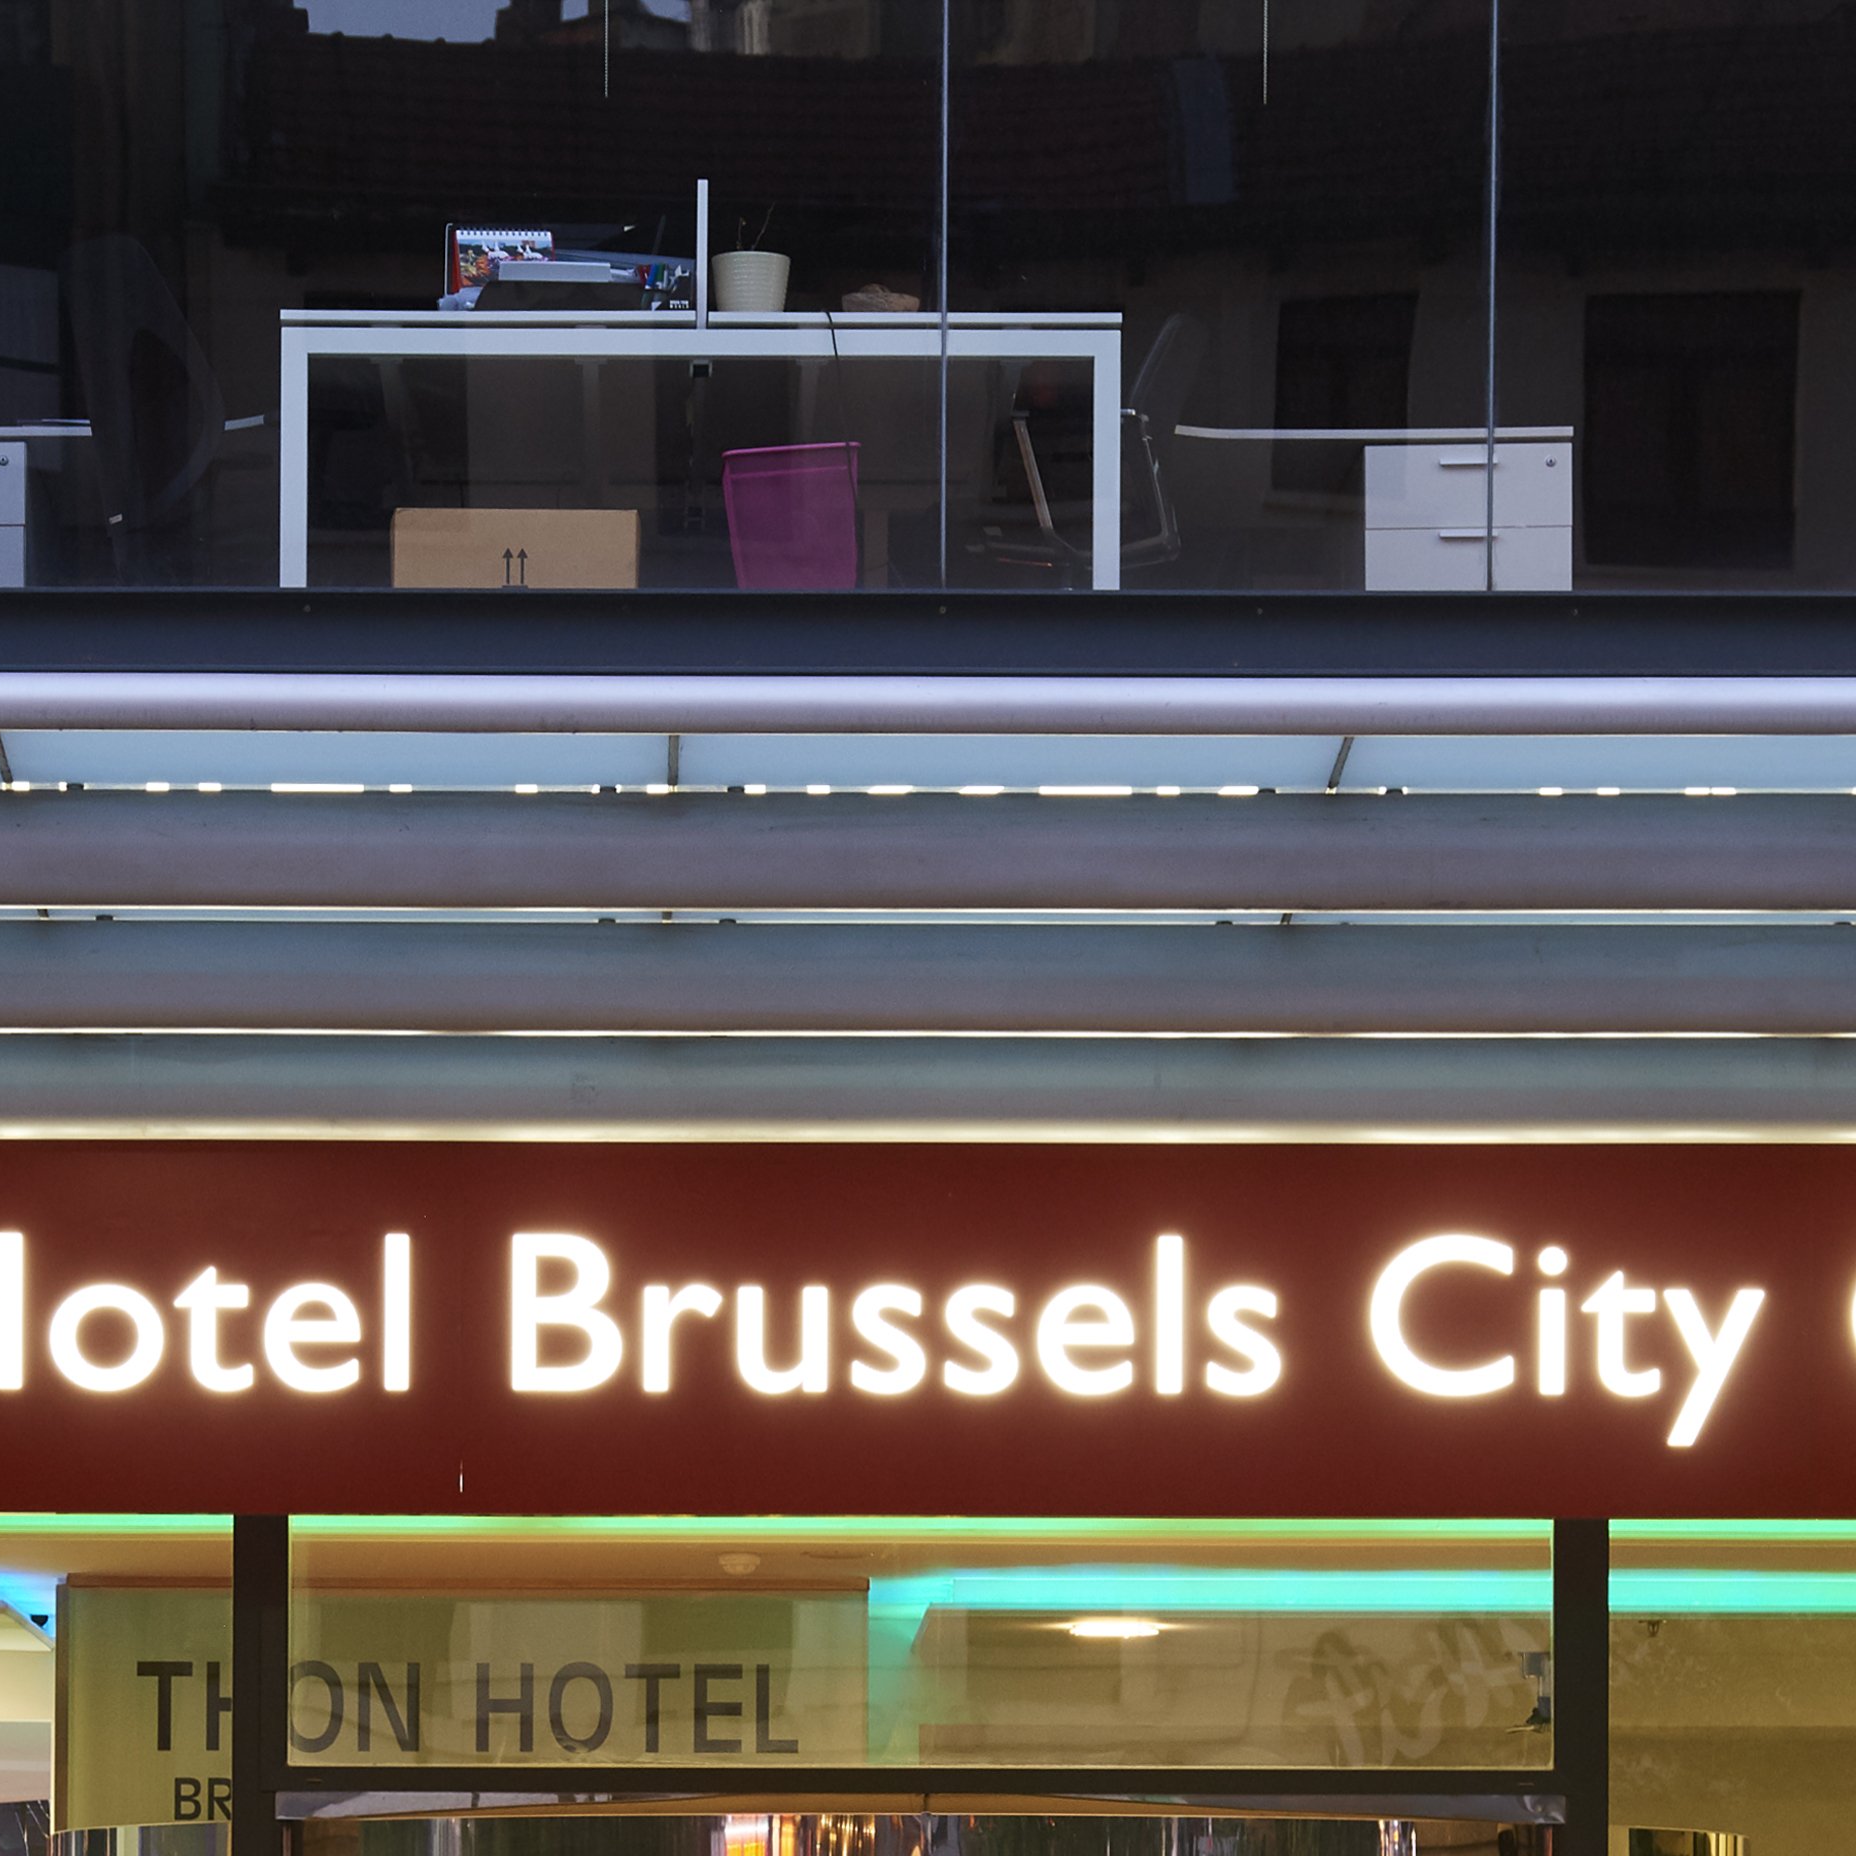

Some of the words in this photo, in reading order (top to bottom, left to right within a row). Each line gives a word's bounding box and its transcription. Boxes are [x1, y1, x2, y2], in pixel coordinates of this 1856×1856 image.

[510, 1232, 1282, 1396] Brussels
[1369, 1233, 1766, 1447] City
[475, 1662, 799, 1754] HOTEL
